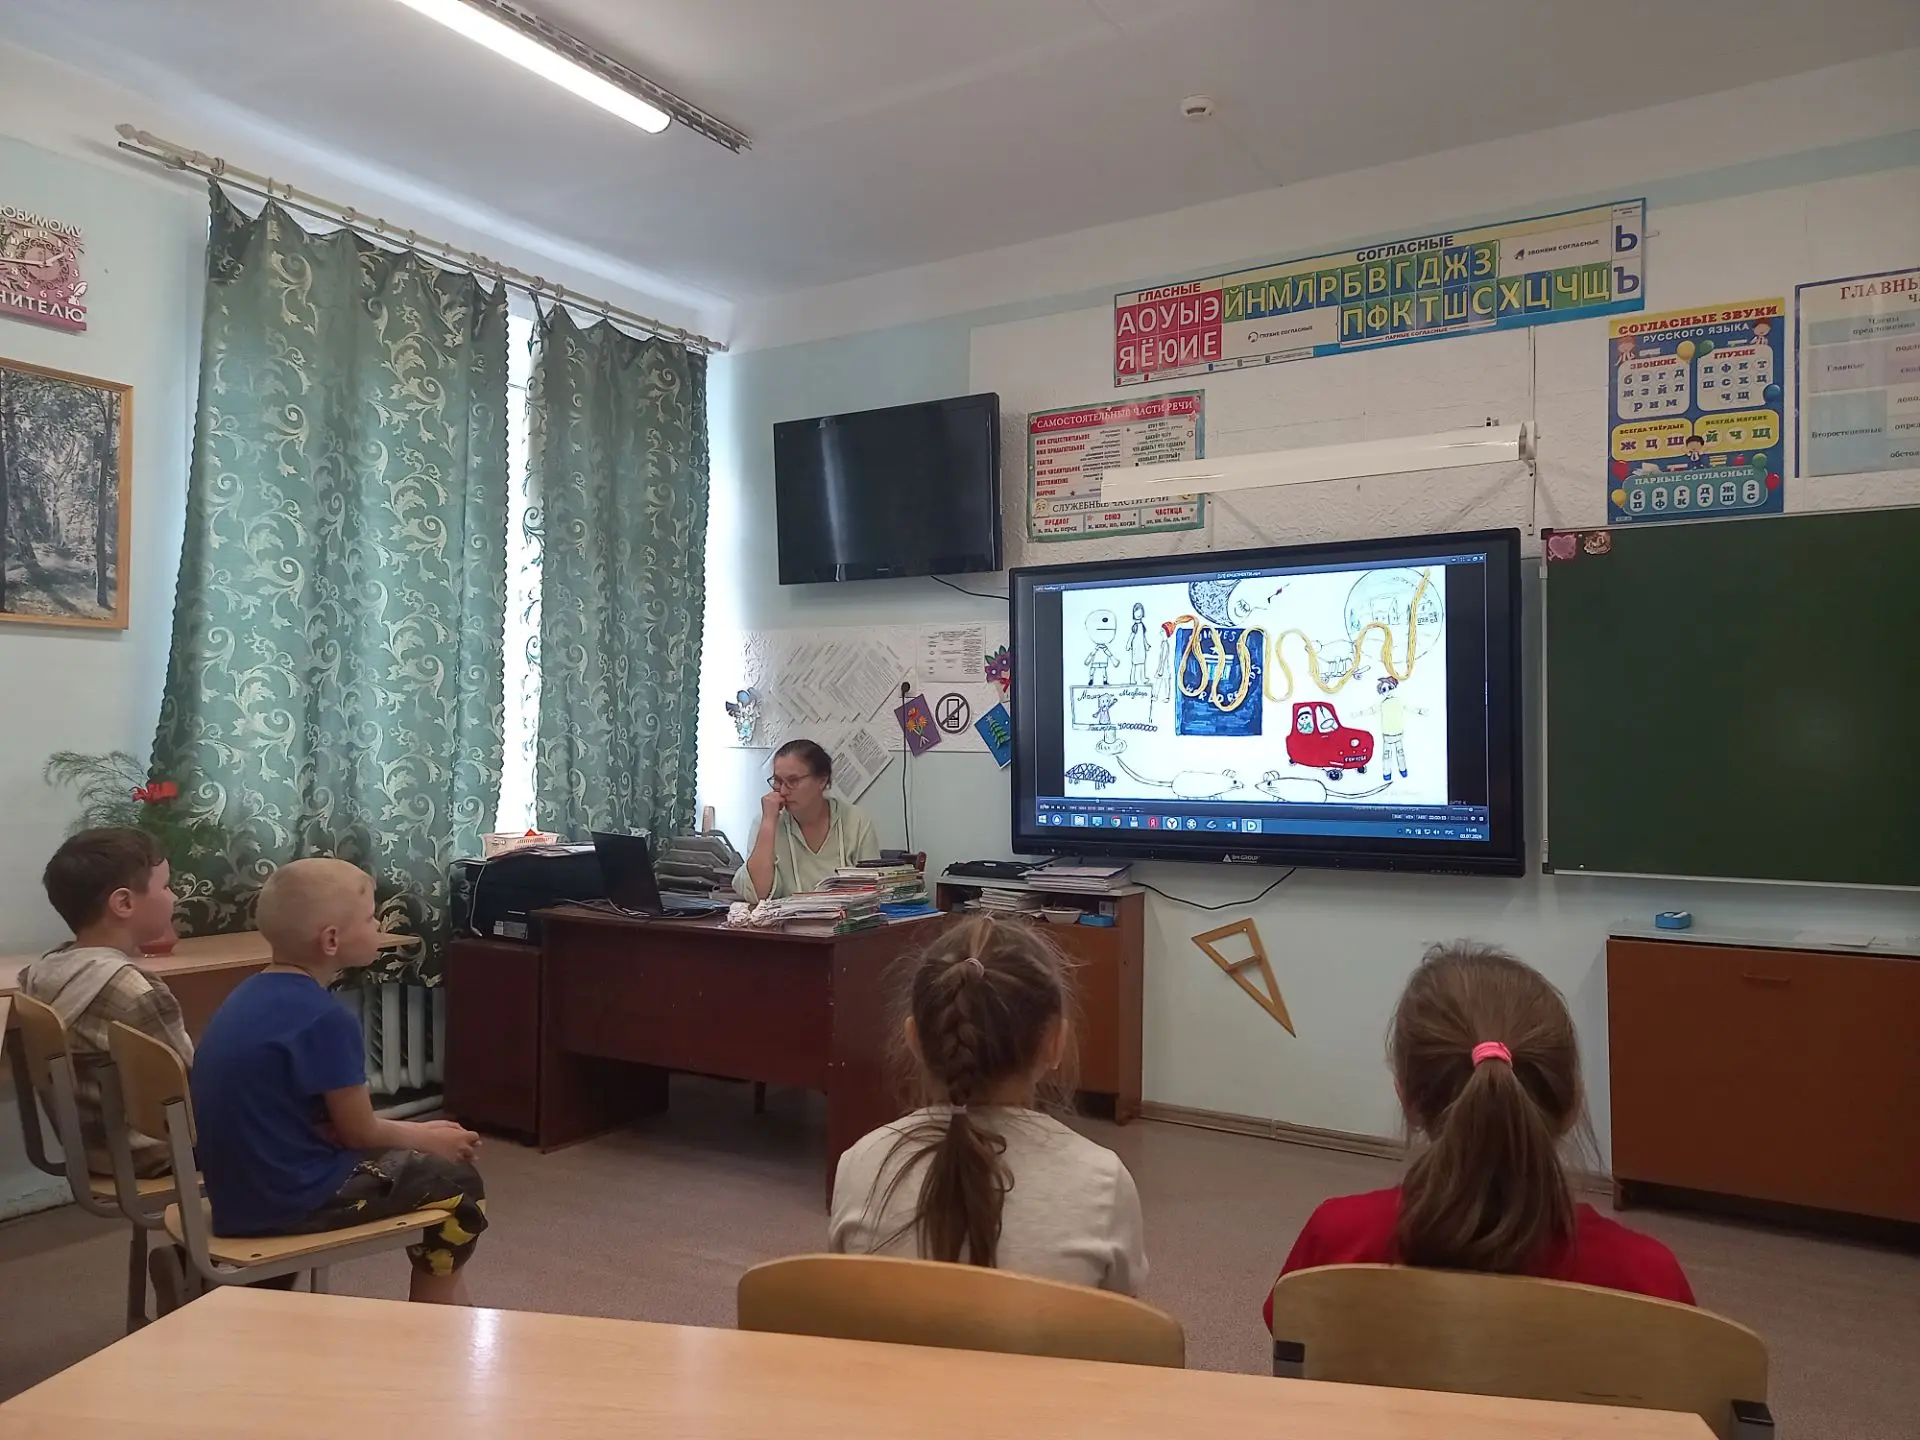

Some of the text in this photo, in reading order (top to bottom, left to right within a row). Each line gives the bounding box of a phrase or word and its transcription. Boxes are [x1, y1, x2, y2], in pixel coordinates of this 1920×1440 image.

[1356, 236, 1454, 262] СОГЛАСНЫЕ
[1138, 283, 1200, 302] ГЛАСНЫЕ
[1618, 305, 1778, 335] СОГЛАСНЫЕ ЗВУКИ
[1643, 322, 1750, 343] РУССКОГО ЯЗЫКА
[1714, 348, 1756, 360] ГЛУХИЕ
[1037, 409, 1131, 429] САМОСТОЯТЕЛЬНЫЕ
[1166, 400, 1193, 411] РЕЧИ
[1635, 468, 1754, 485] ПАРНЫЕ СОГЛАСНЫЕ
